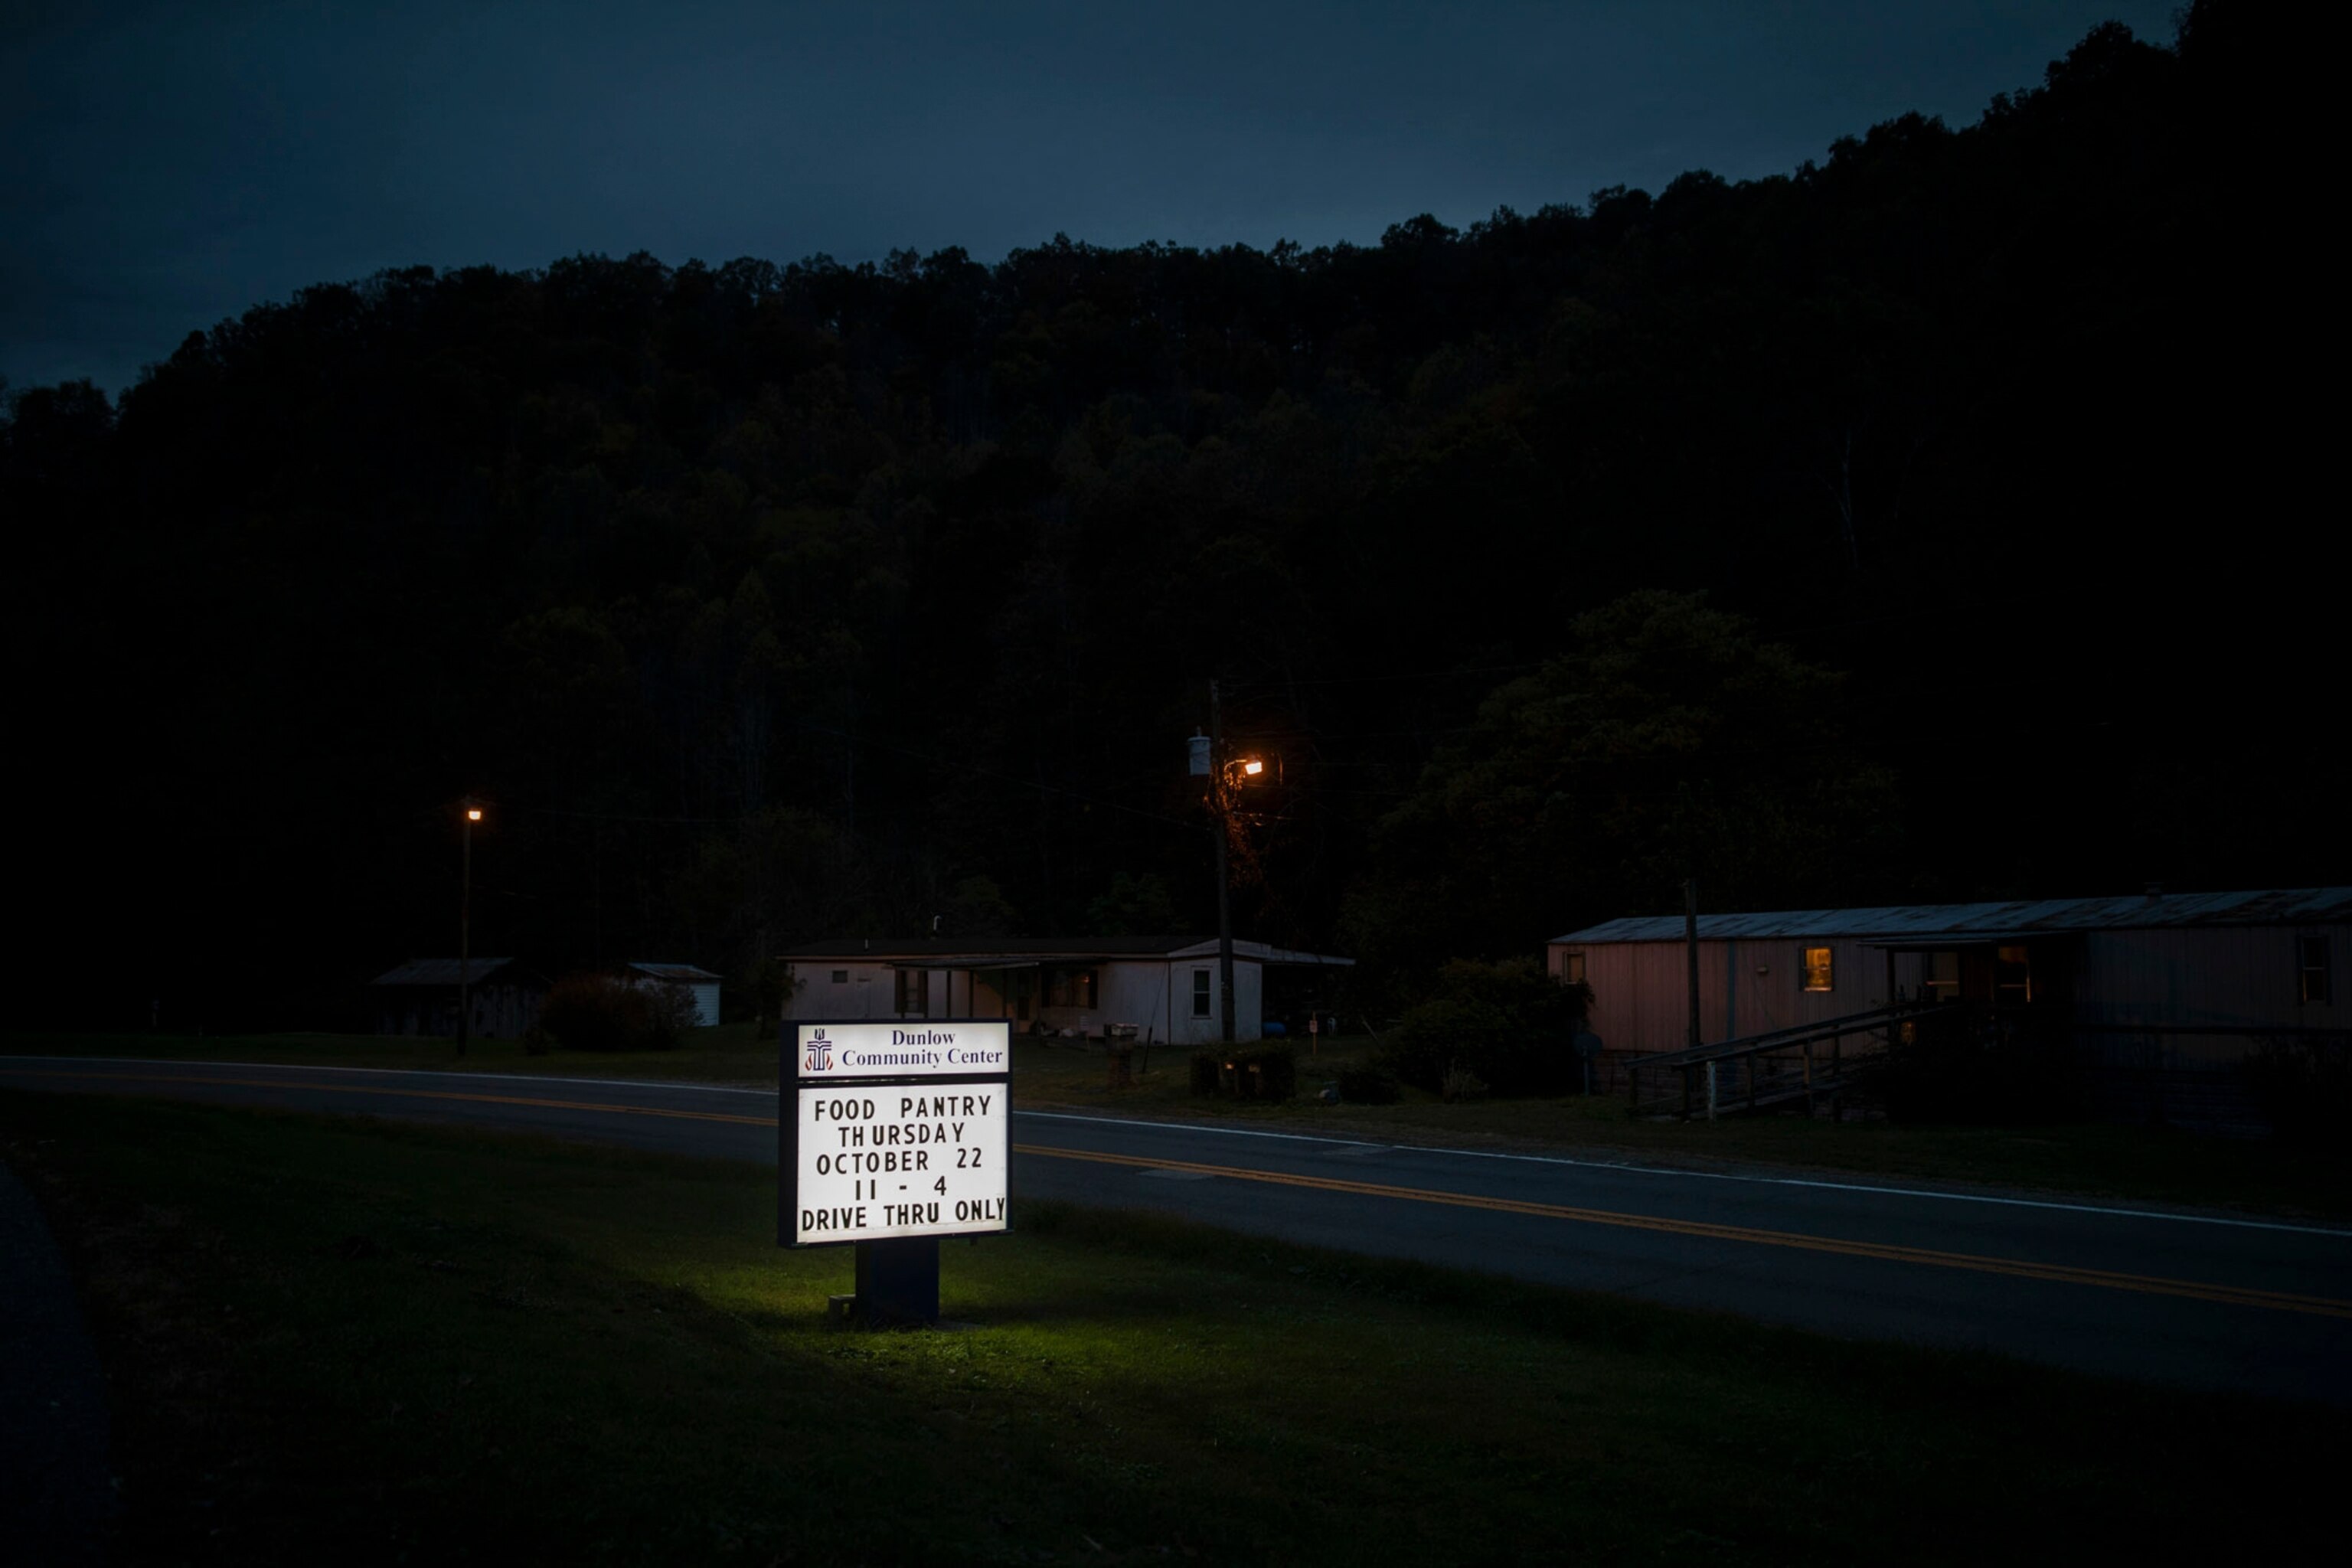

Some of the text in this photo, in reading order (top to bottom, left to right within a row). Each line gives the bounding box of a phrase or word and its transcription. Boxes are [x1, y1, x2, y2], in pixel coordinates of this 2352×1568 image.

[892, 1030, 956, 1045] Dunlow
[842, 1048, 1003, 1067] Community Center
[815, 1096, 991, 1121] FOOD PANTRY
[838, 1122, 965, 1147] THURSDAY
[817, 1148, 982, 1175] OCTOBER 22
[855, 1180, 876, 1200] 11
[934, 1176, 946, 1196] 4
[802, 1197, 1004, 1231] DRIVE THRU ONLY
